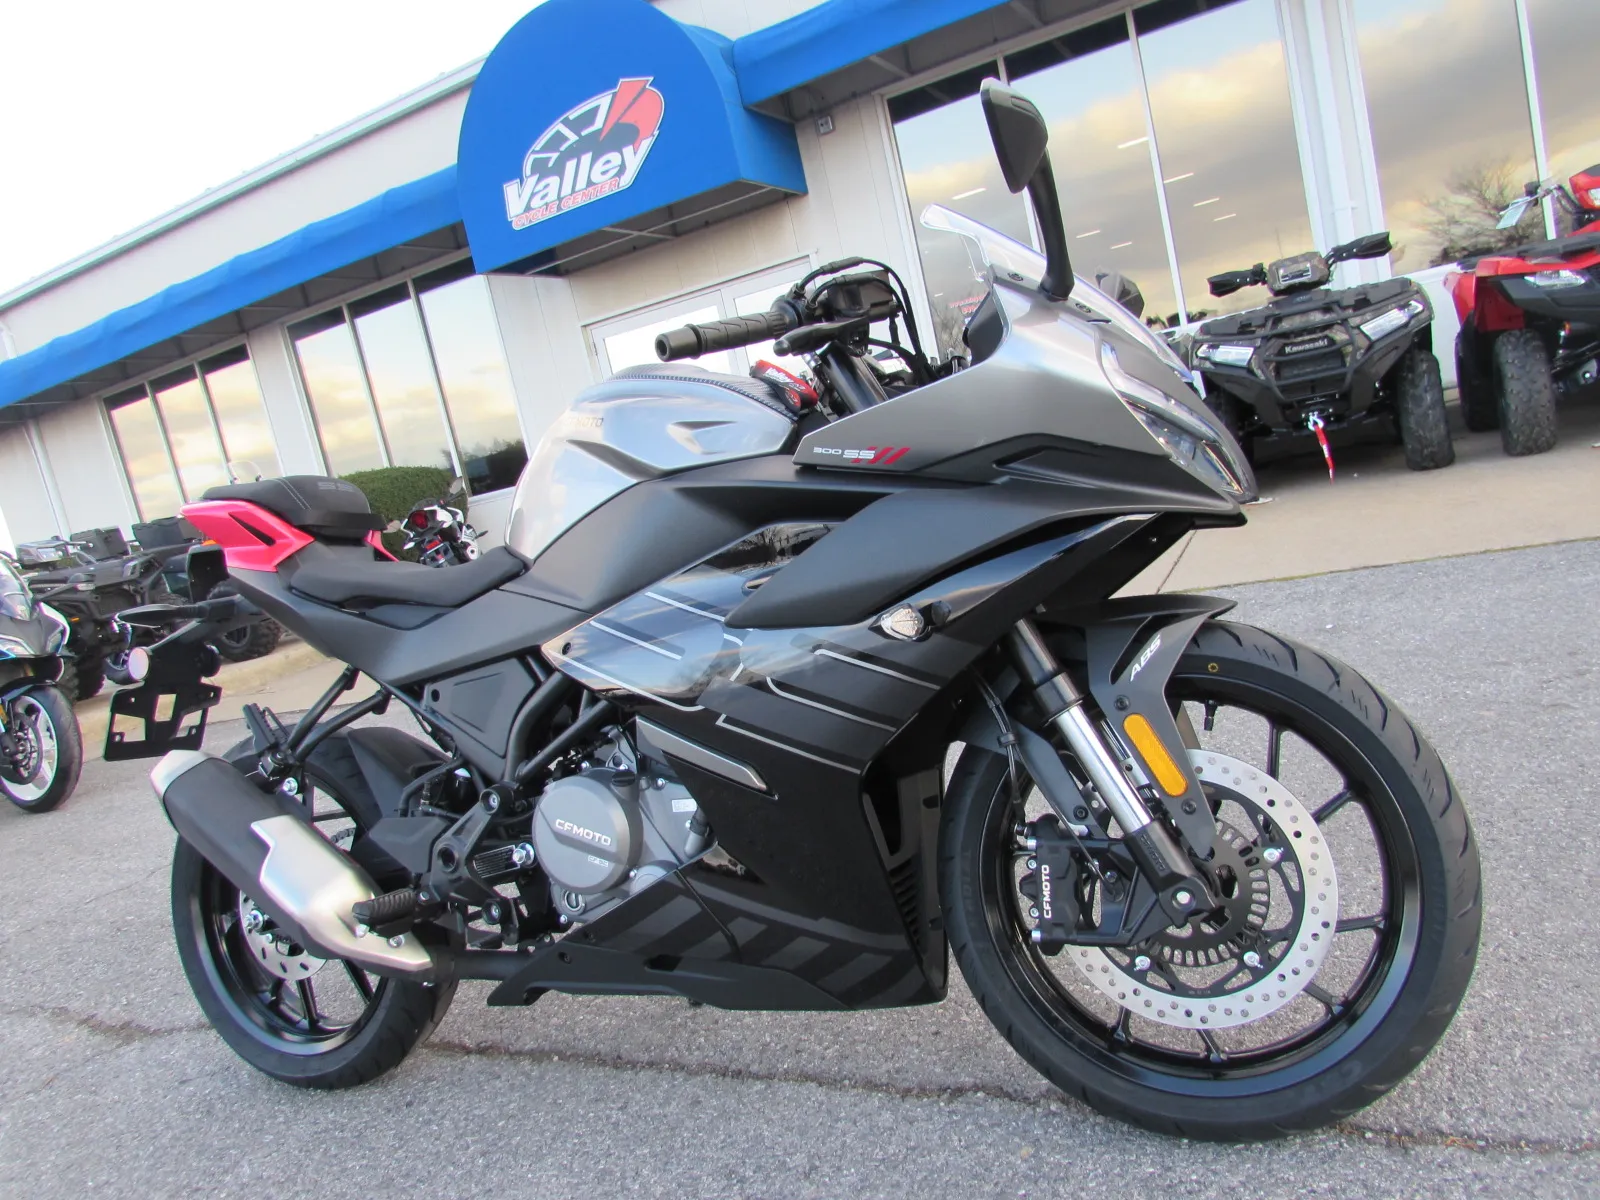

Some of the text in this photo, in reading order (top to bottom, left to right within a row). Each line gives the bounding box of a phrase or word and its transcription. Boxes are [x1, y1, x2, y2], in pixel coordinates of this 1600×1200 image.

[505, 136, 654, 217] Valley
[513, 177, 620, 228] CYCLE CENTER
[1284, 339, 1329, 354] Kawasaki
[813, 446, 876, 460] 300 SS
[1130, 633, 1161, 682] ABS
[555, 818, 612, 846] CFMOTO
[1041, 864, 1052, 919] CFMOTO
